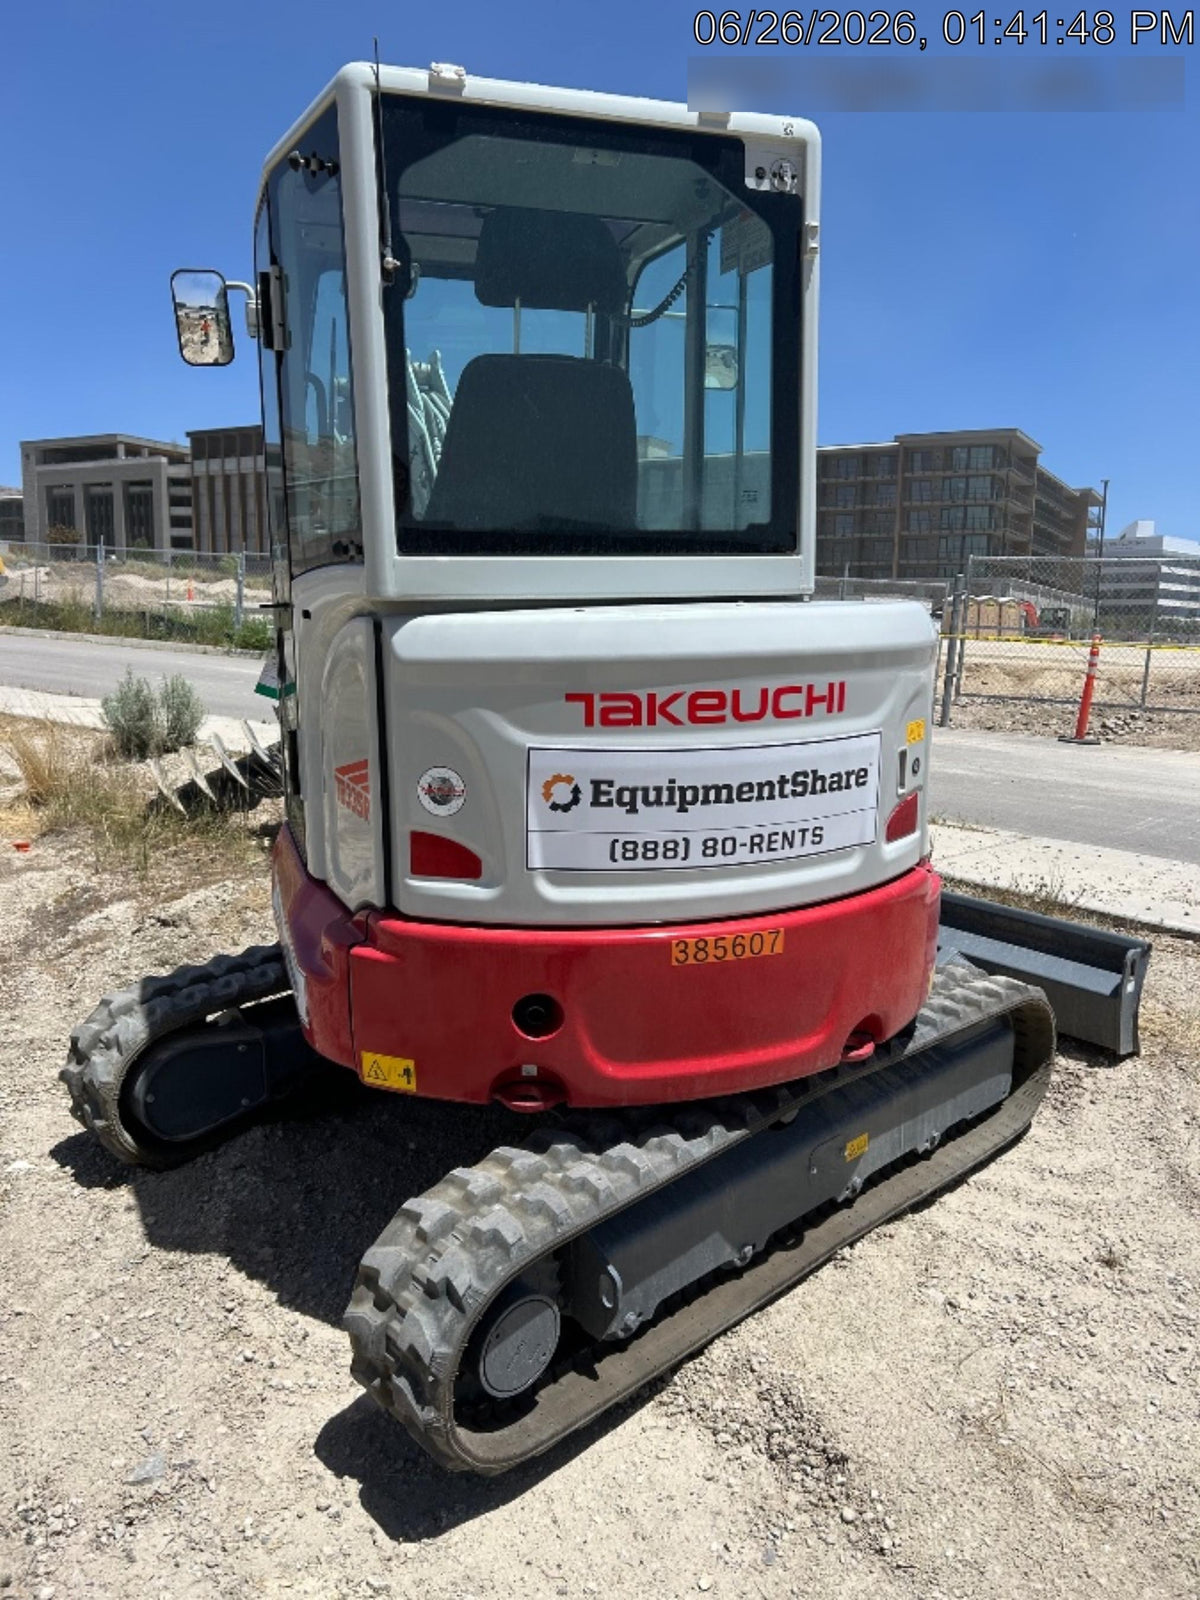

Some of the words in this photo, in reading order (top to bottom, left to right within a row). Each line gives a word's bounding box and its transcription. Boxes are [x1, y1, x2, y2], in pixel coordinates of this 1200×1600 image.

[565, 681, 847, 727] TAKEUCHI
[589, 767, 869, 815] EquipmentShare
[609, 838, 691, 863] (888)
[701, 826, 824, 858] 80-RENTS
[673, 930, 782, 965] 385607
